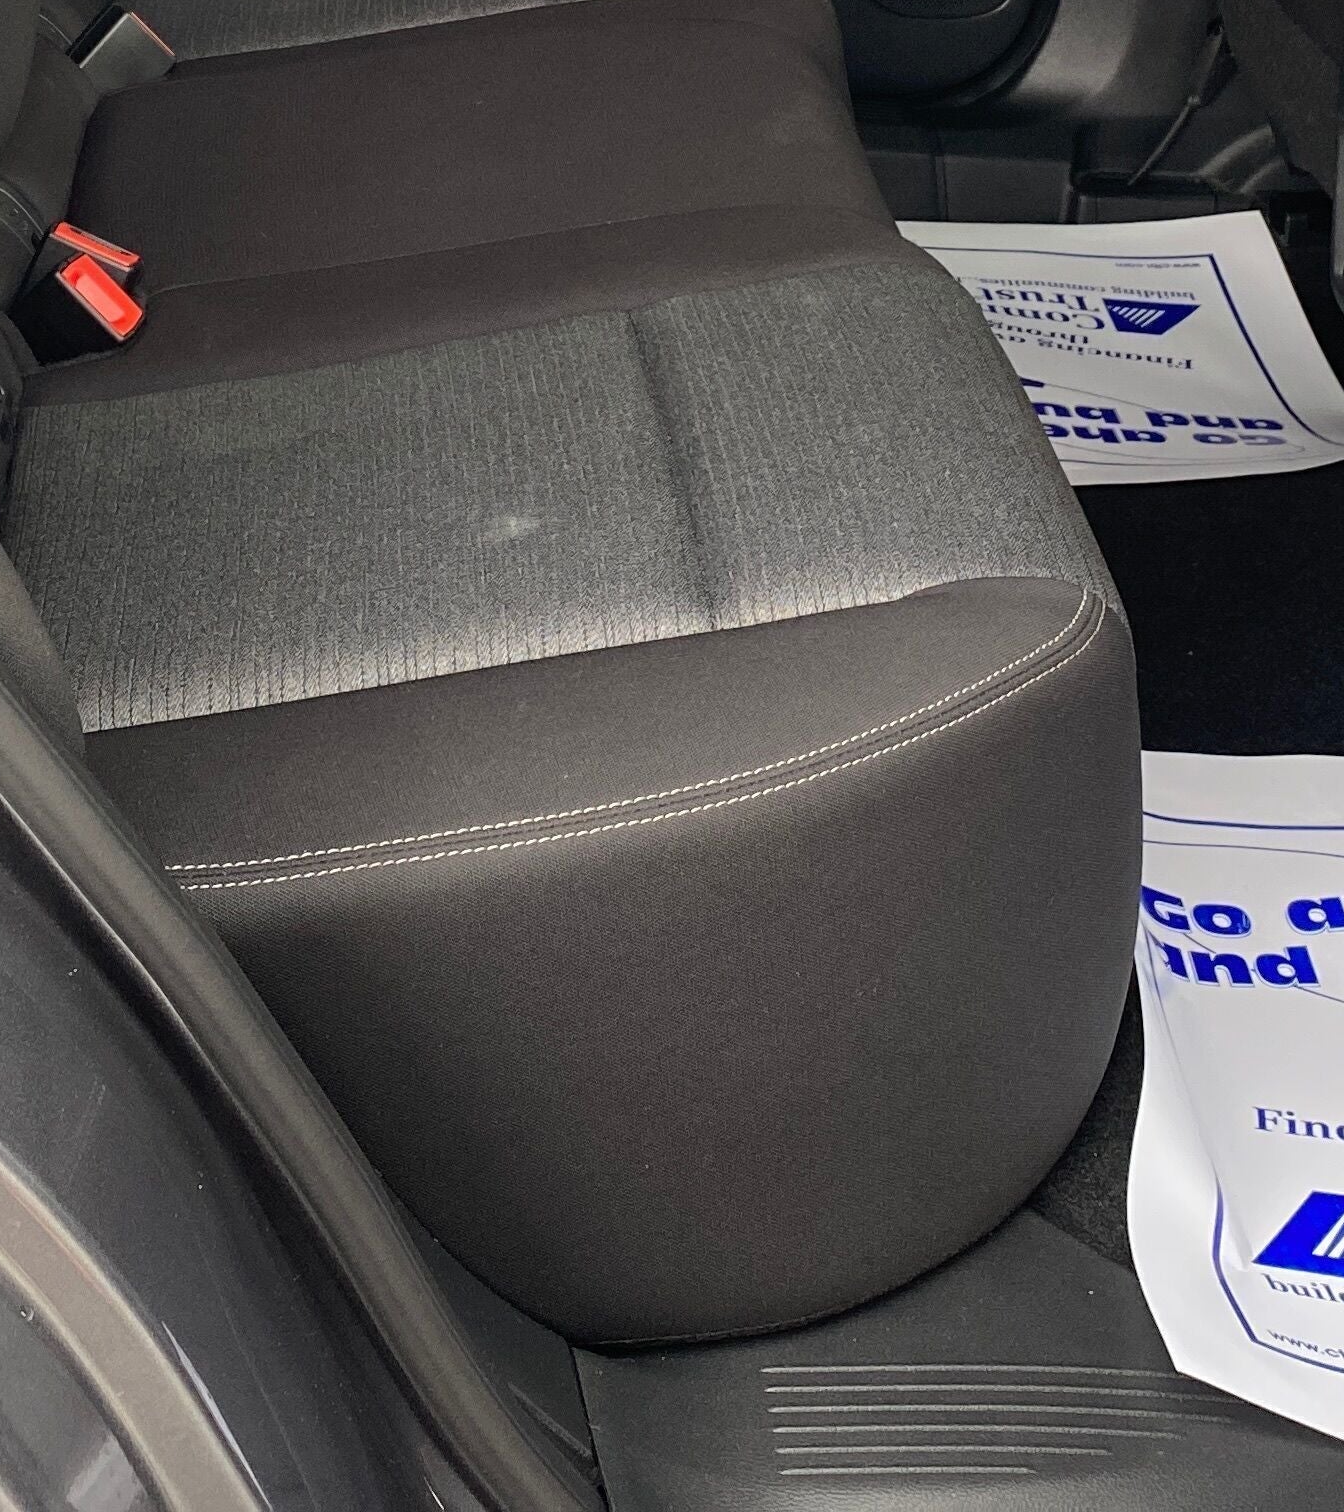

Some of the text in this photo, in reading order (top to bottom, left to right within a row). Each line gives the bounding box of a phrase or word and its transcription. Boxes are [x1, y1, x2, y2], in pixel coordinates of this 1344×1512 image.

[1036, 337, 1193, 371] Financing
[1145, 410, 1284, 430] and
[1141, 884, 1253, 938] Go
